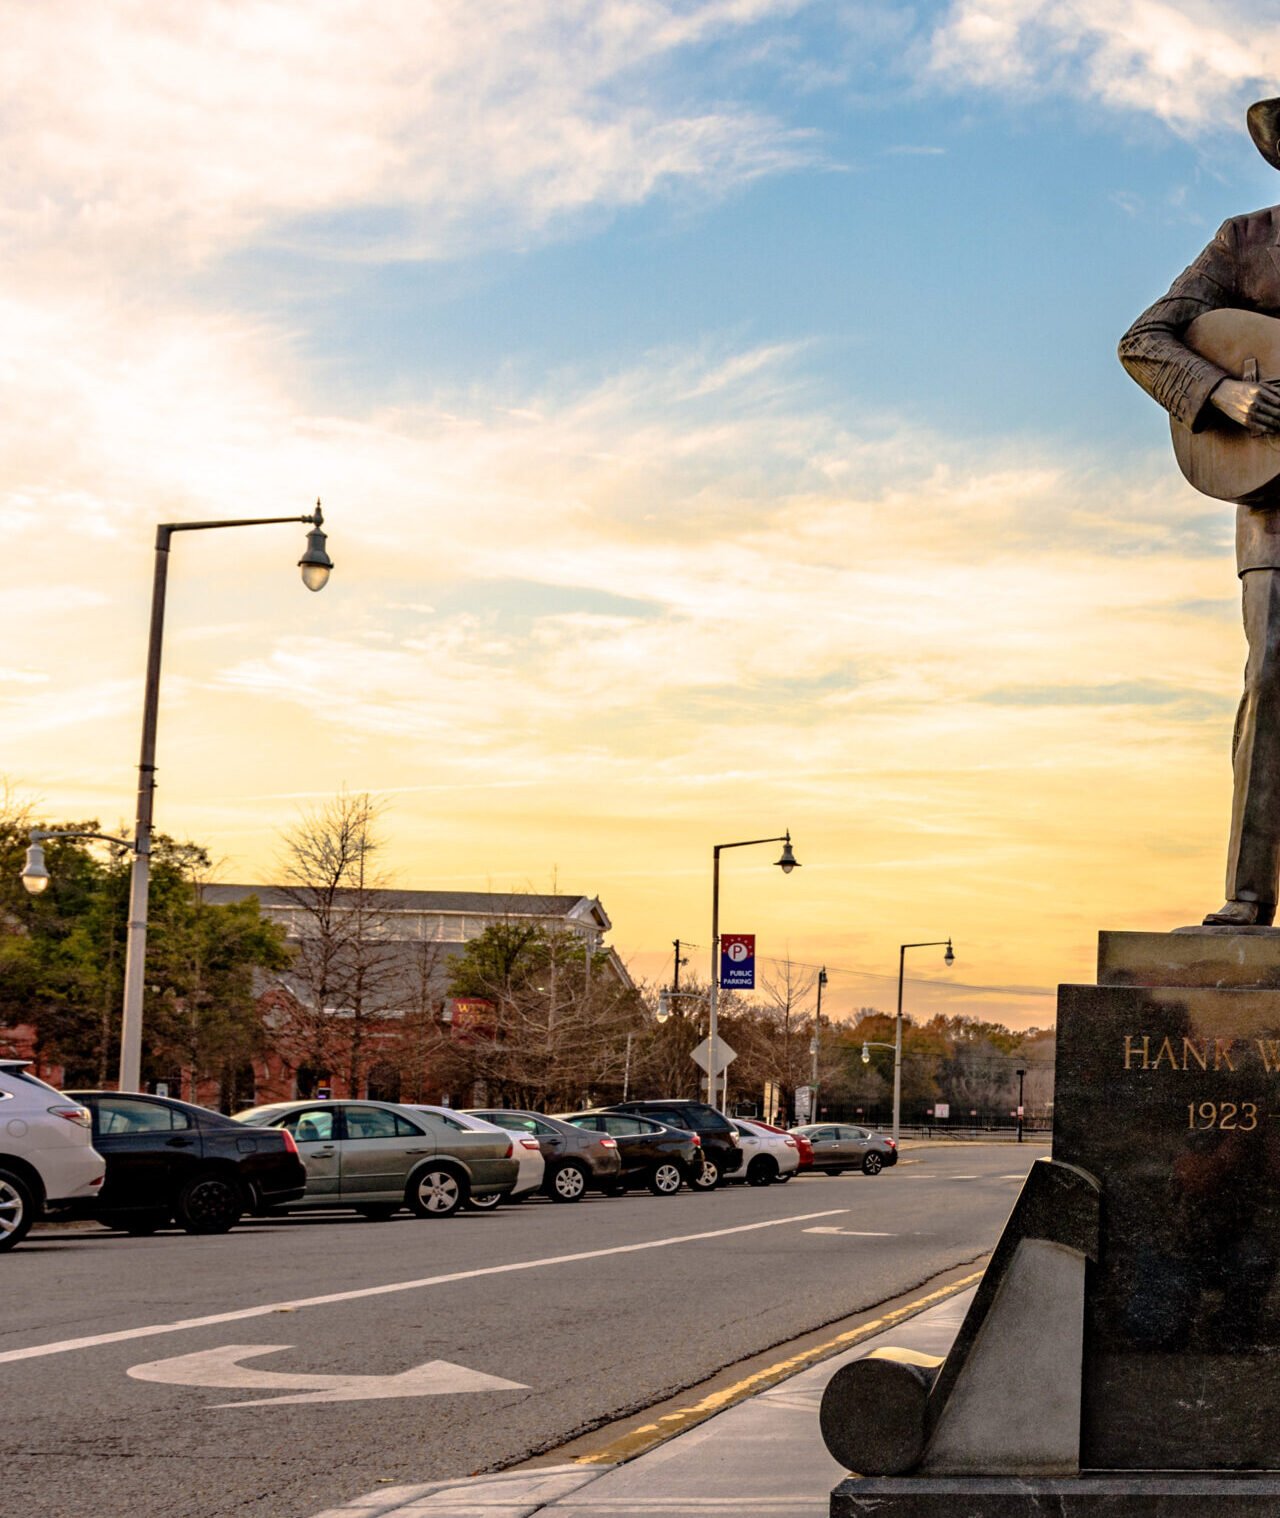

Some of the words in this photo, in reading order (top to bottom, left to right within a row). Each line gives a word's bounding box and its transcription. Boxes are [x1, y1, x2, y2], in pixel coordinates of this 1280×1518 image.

[733, 945, 742, 959] P
[1123, 1035, 1238, 1072] HANK
[1187, 1101, 1258, 1131] 1923
